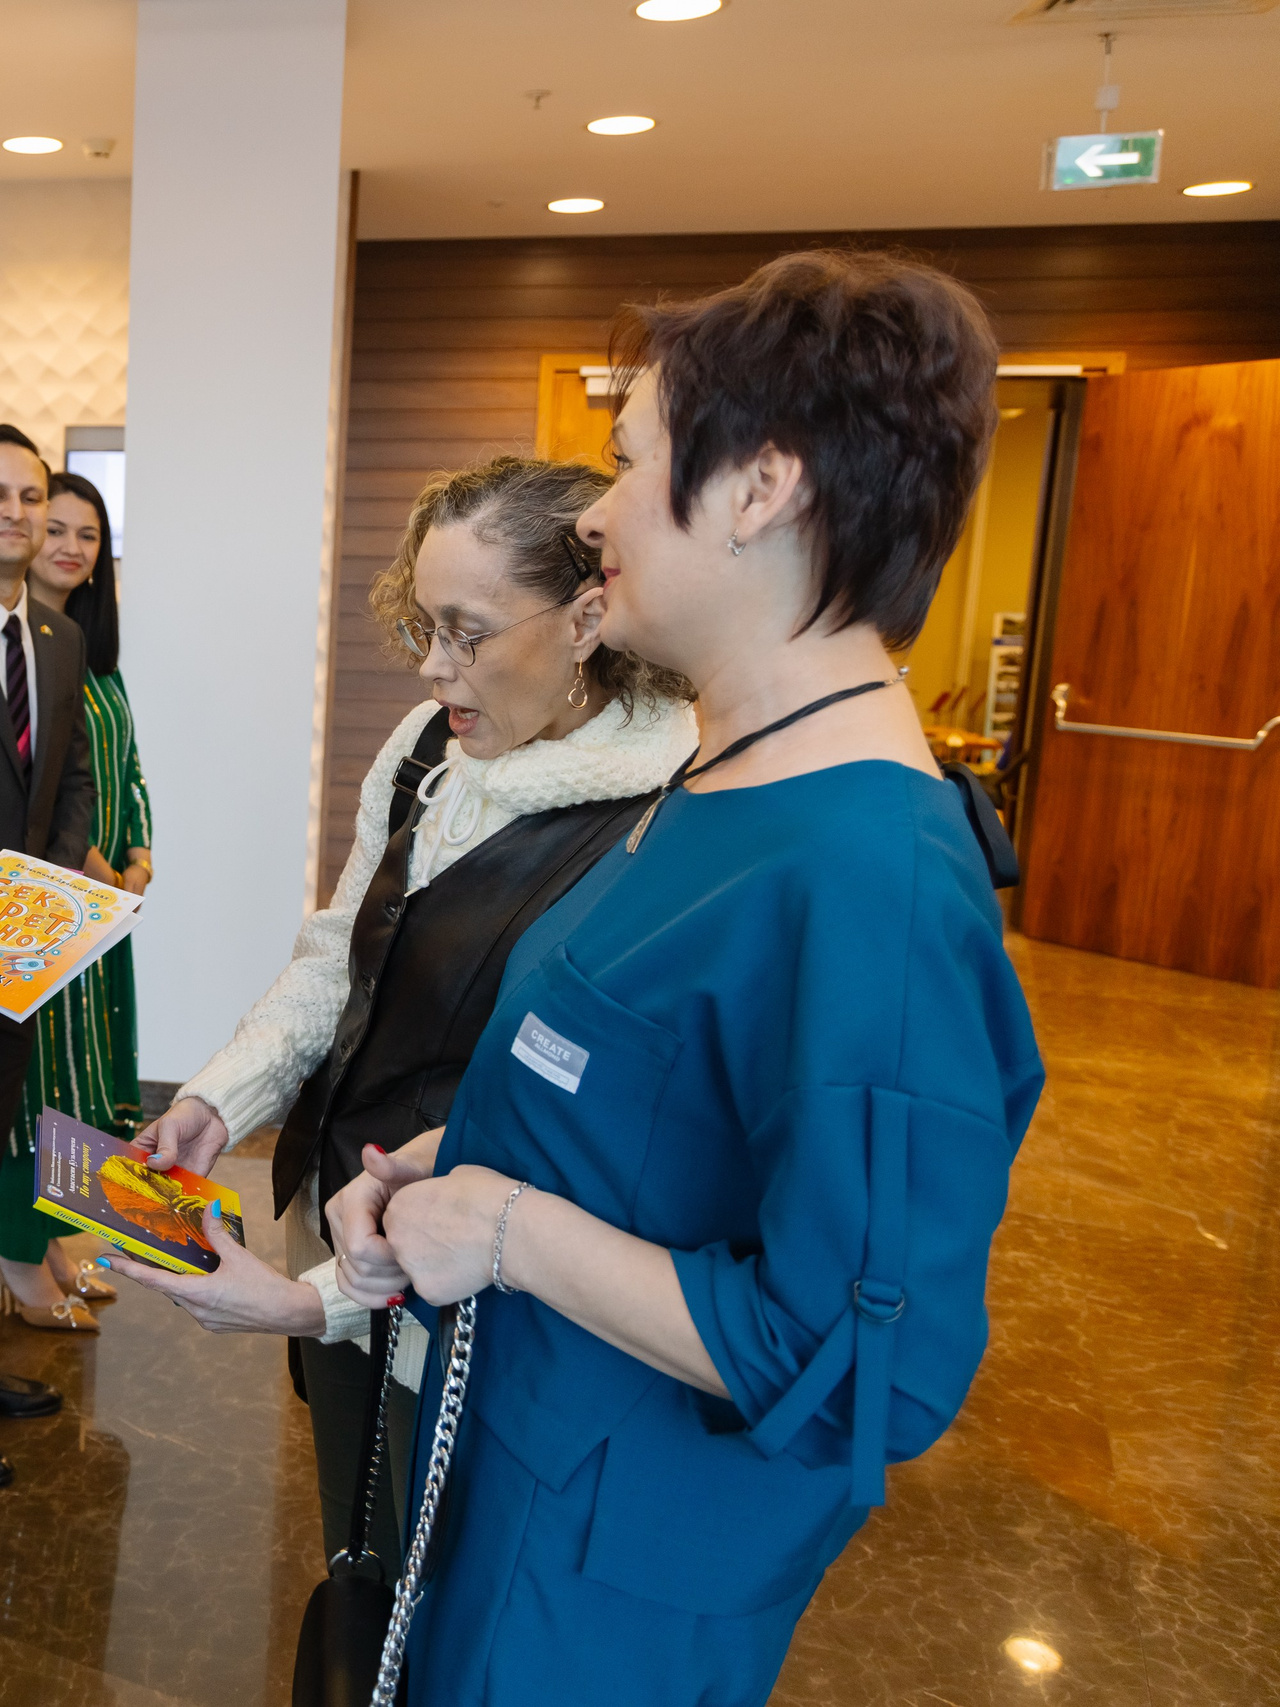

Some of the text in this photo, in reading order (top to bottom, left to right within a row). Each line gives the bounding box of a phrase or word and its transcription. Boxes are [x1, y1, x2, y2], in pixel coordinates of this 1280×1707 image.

[531, 1029, 571, 1061] CREATE
[79, 1142, 92, 1198] По ту сторону
[54, 1210, 96, 1231] сторону
[108, 1237, 126, 1248] По
